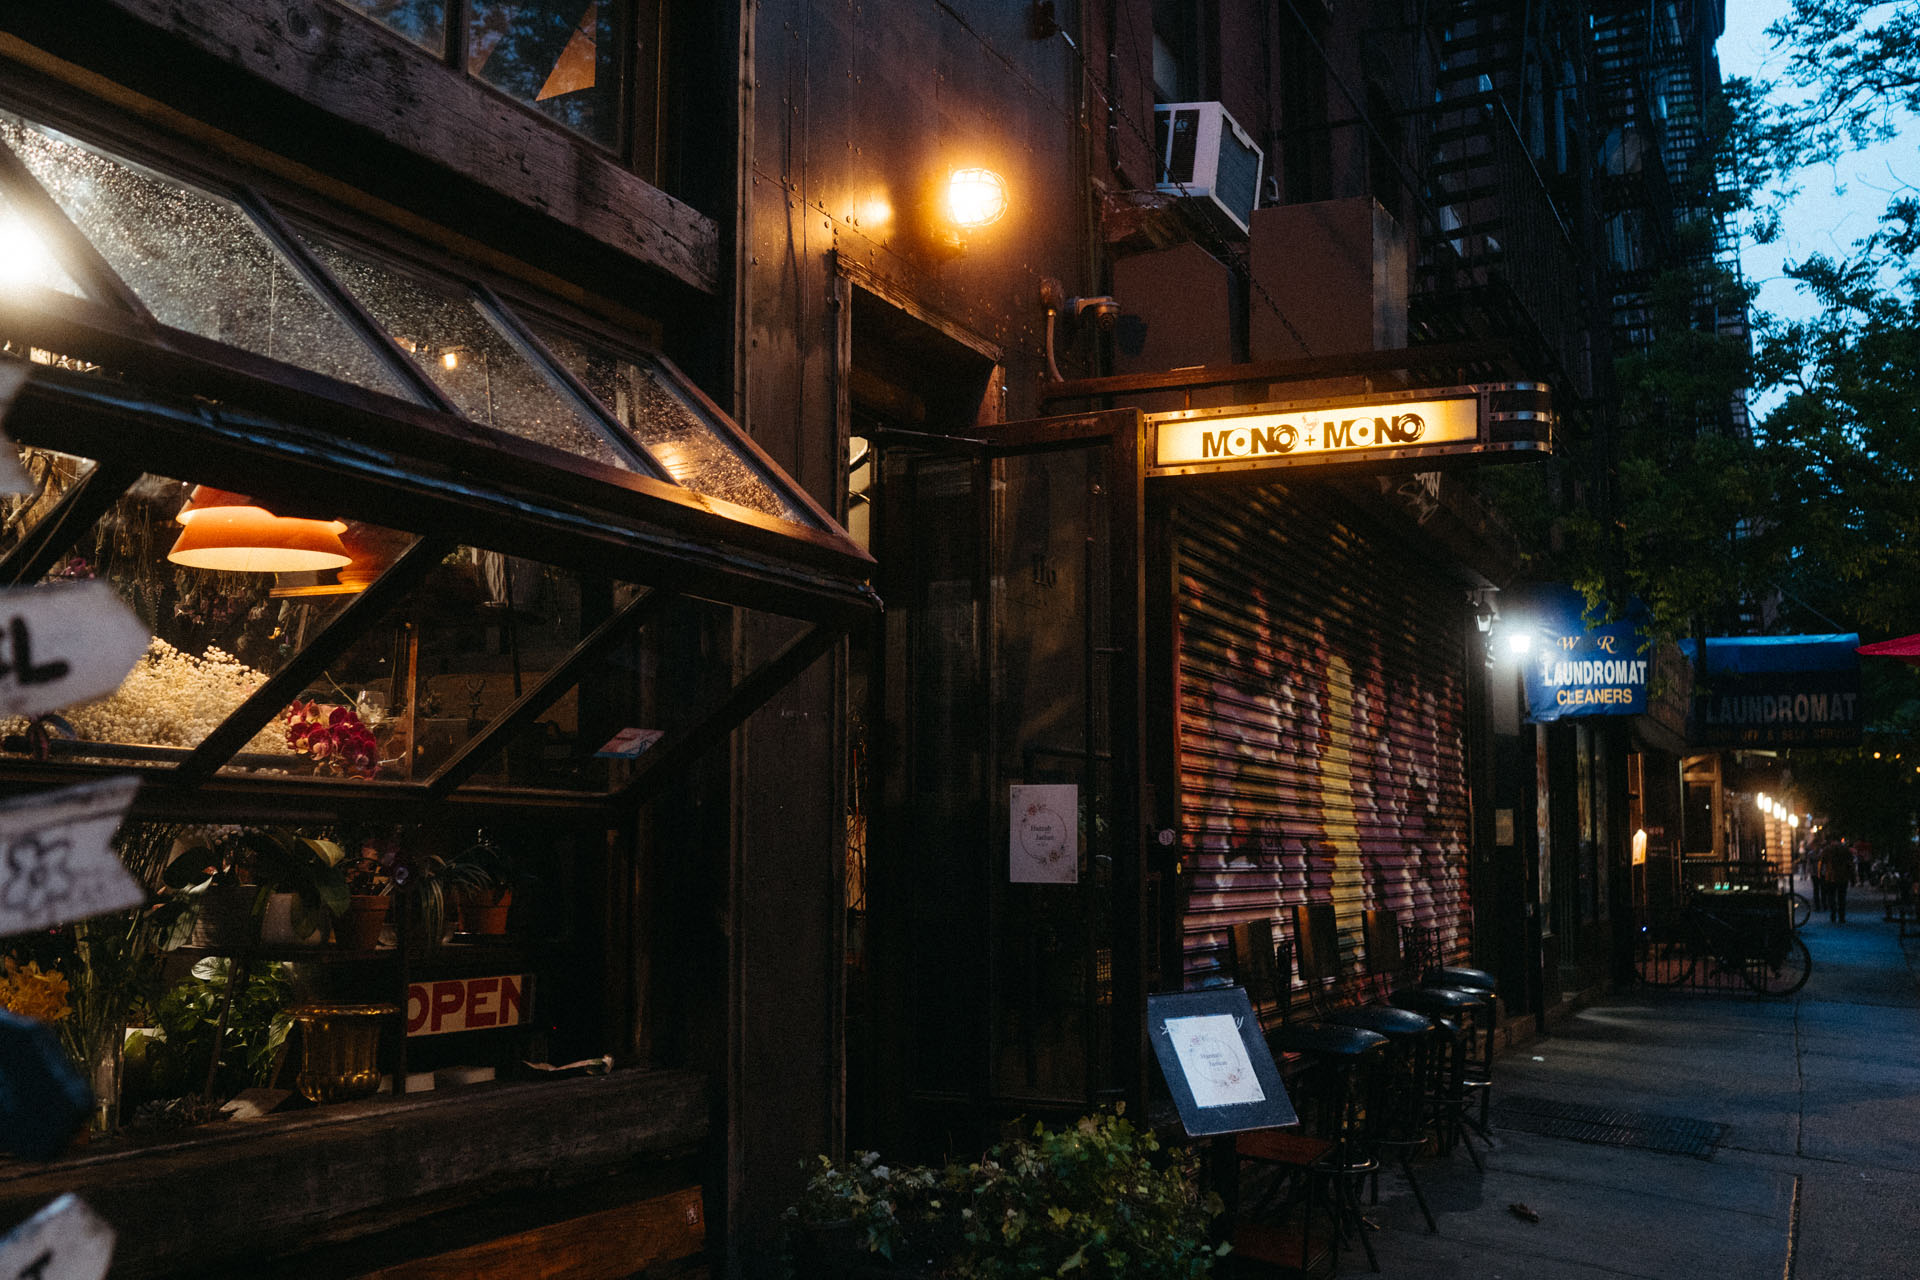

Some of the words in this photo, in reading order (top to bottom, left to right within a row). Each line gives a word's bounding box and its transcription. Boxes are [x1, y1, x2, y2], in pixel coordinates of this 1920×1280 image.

[1202, 424, 1299, 457] MONO
[1323, 413, 1425, 448] MONO
[1597, 635, 1617, 654] R
[1544, 660, 1648, 686] LAUNDROMAT
[1556, 688, 1633, 705] CLEANERS
[1705, 693, 1857, 724] LAUNDROMAT
[408, 977, 528, 1033] OPEN
